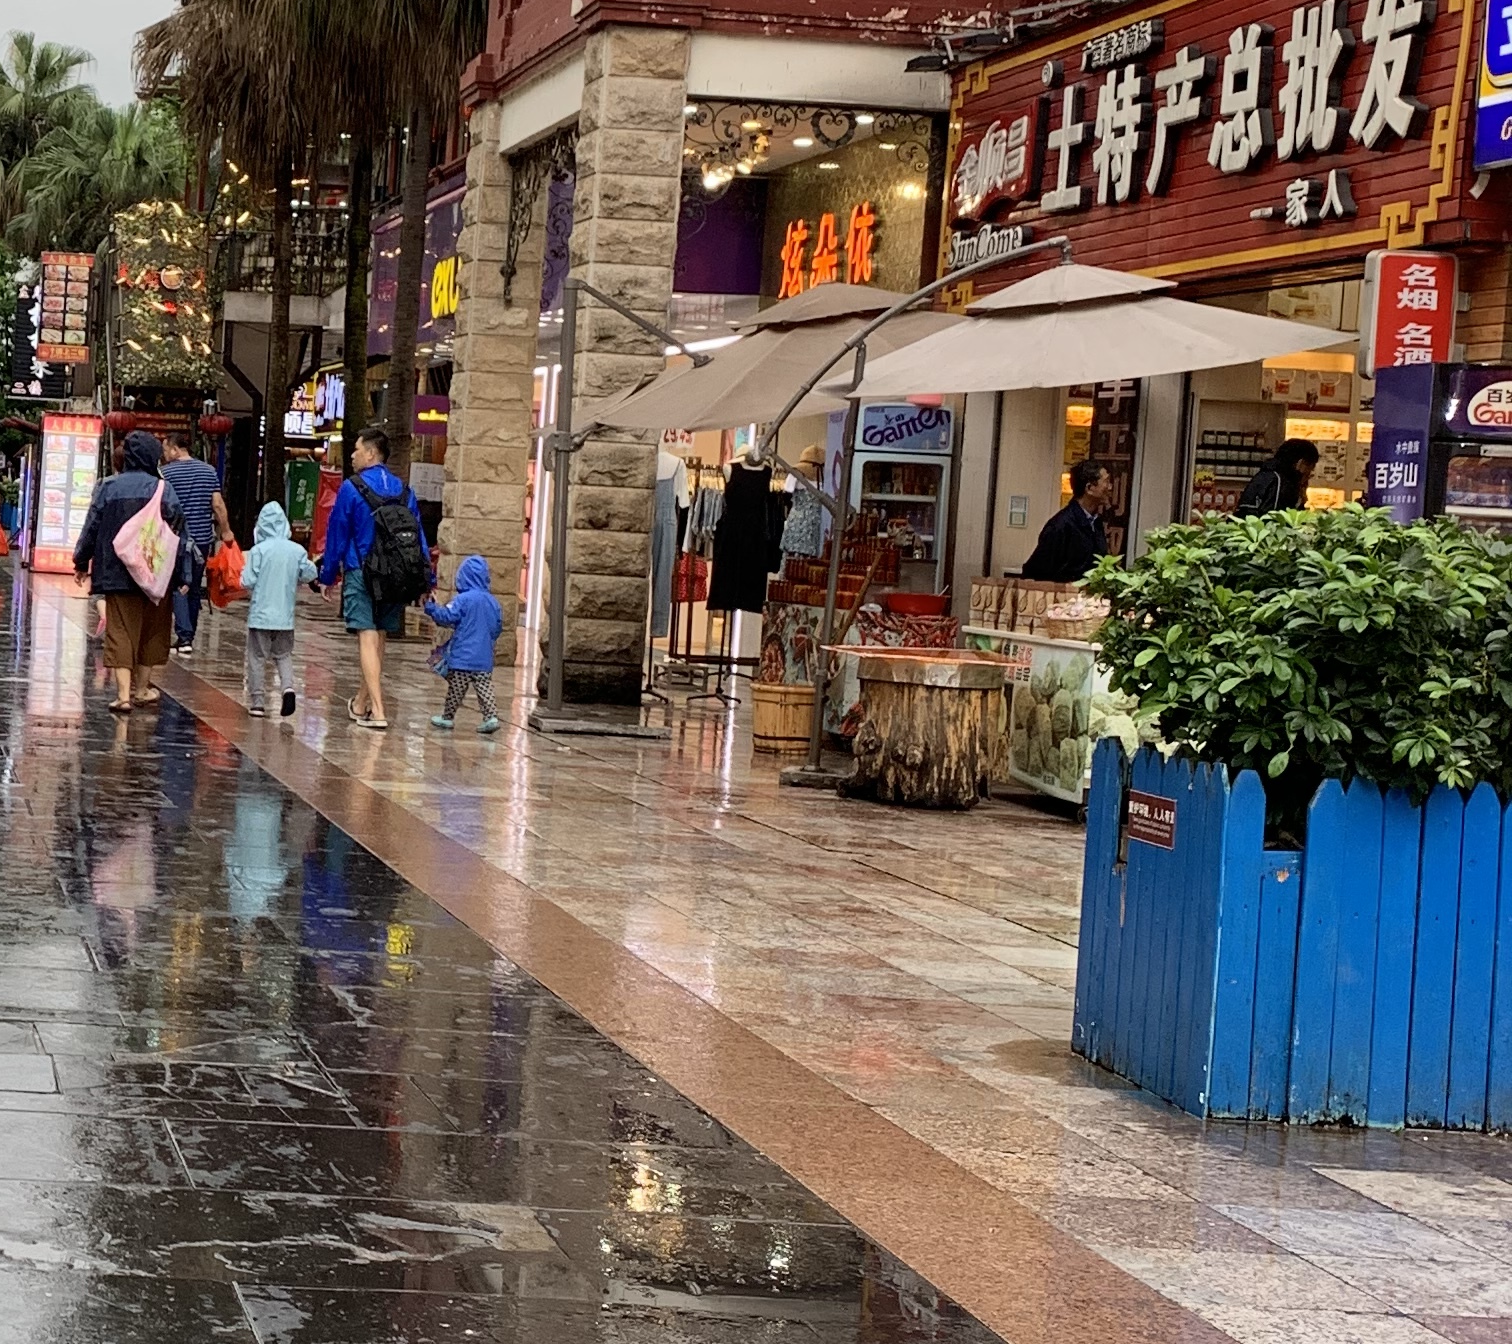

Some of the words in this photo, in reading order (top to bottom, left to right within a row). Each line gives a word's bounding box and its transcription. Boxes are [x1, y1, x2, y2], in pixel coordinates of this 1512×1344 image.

[1250, 169, 1344, 227] 一家人
[778, 201, 874, 298] 炫朵依
[948, 224, 1024, 269] SunCome
[1397, 263, 1439, 311] 名烟
[1393, 322, 1434, 367] 名酒
[862, 407, 951, 447] Ganten
[1374, 462, 1419, 489] 百岁山
